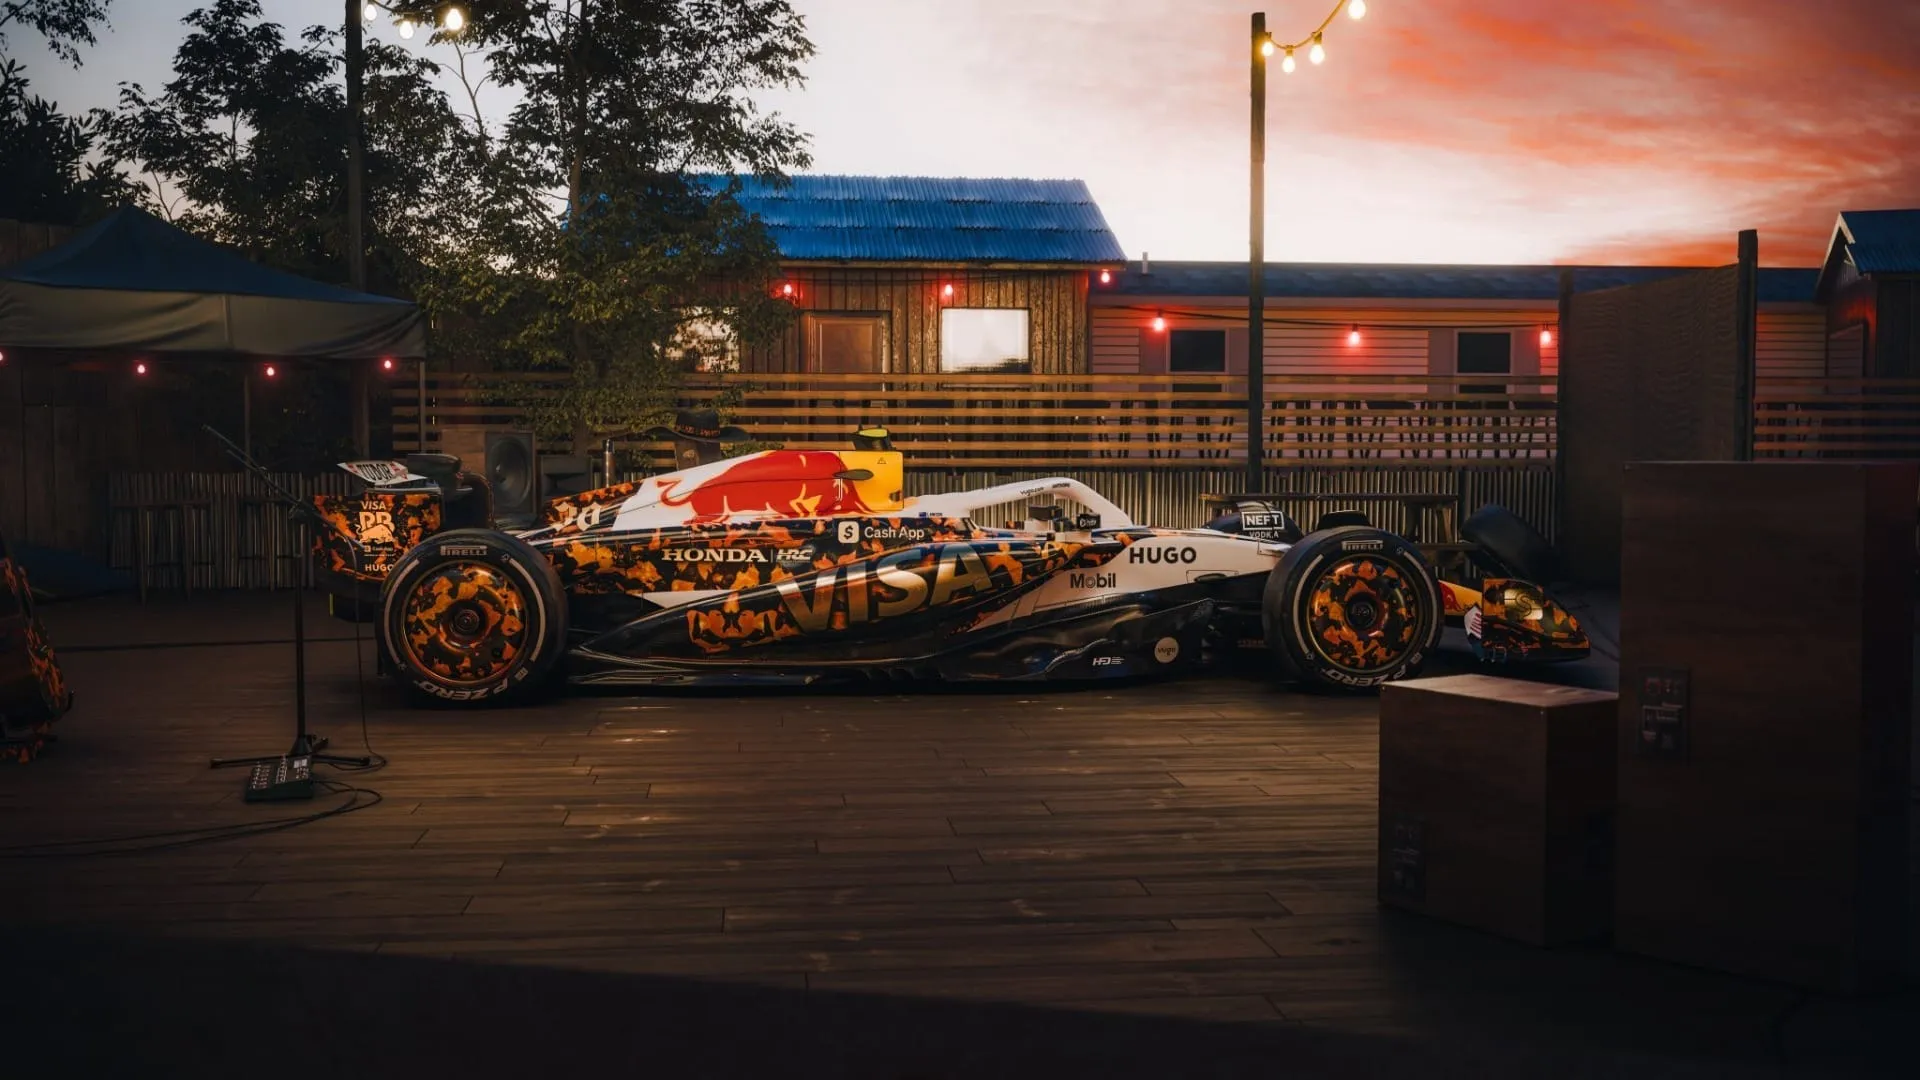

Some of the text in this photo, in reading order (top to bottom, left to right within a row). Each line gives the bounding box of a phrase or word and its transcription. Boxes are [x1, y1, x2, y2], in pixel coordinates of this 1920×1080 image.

[361, 501, 387, 510] VISA
[1246, 514, 1280, 526] NEFT
[864, 526, 925, 541] Cash App
[440, 545, 488, 556] PIRELLI
[1341, 540, 1384, 551] PIRELLI
[661, 548, 769, 563] HONDA
[1129, 546, 1197, 564] HUGO
[777, 542, 993, 632] VISA
[1070, 573, 1116, 589] Mobil
